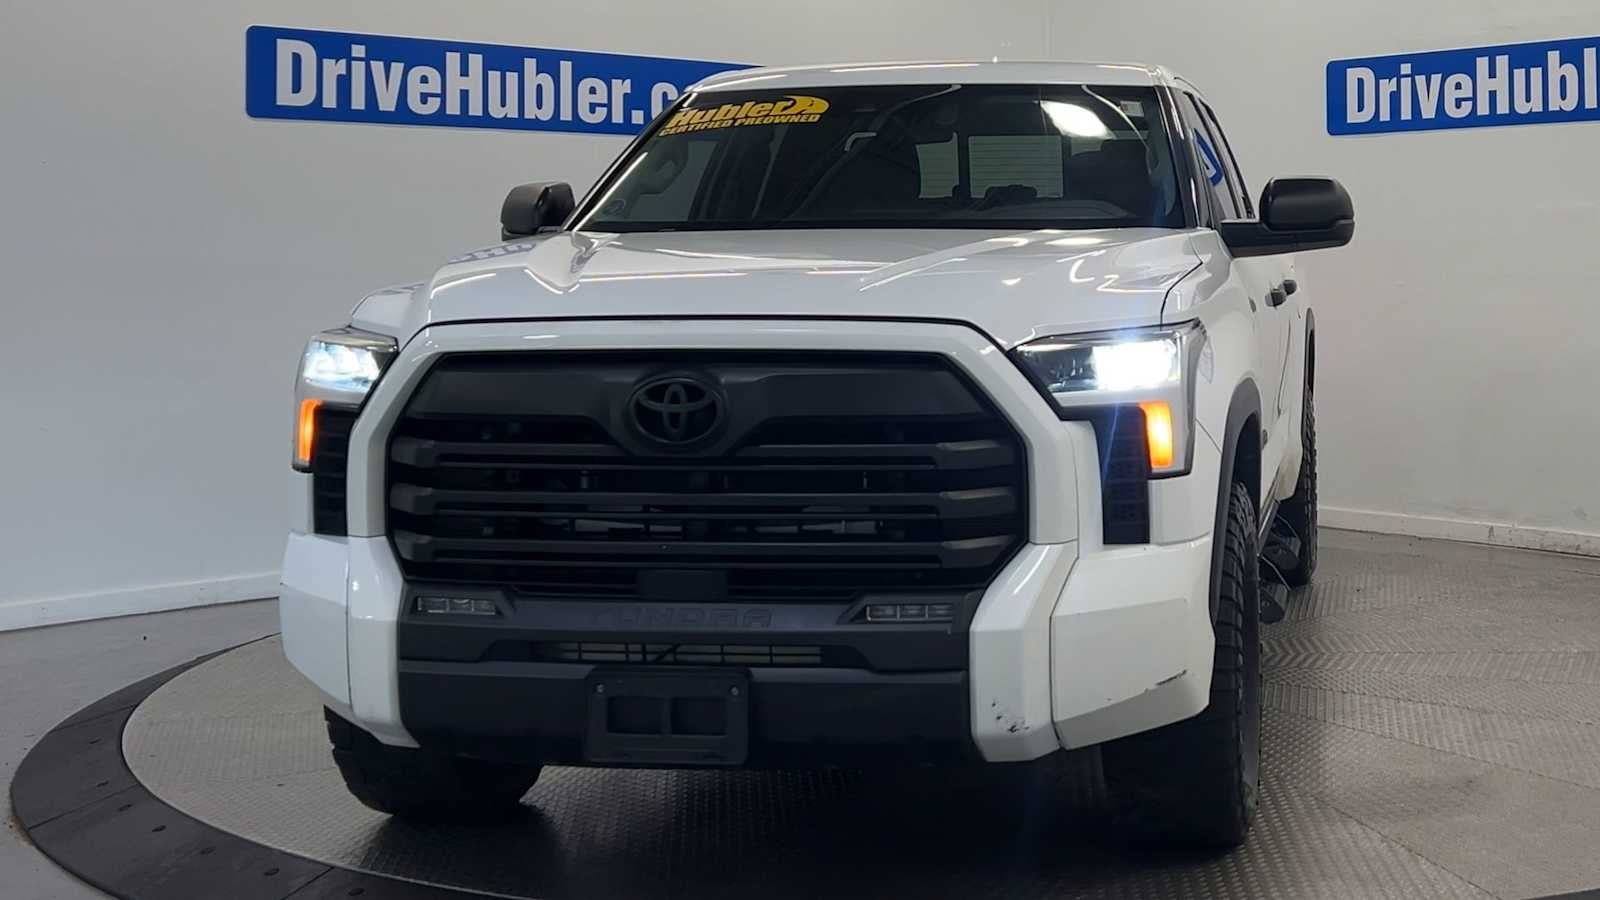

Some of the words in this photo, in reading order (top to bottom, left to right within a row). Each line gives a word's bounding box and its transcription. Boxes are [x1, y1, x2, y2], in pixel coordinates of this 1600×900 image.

[1345, 47, 1598, 124] DriveHubl
[659, 119, 734, 136] CERTIFIED
[734, 114, 822, 127] PREOWNED
[666, 100, 795, 129] Hubler
